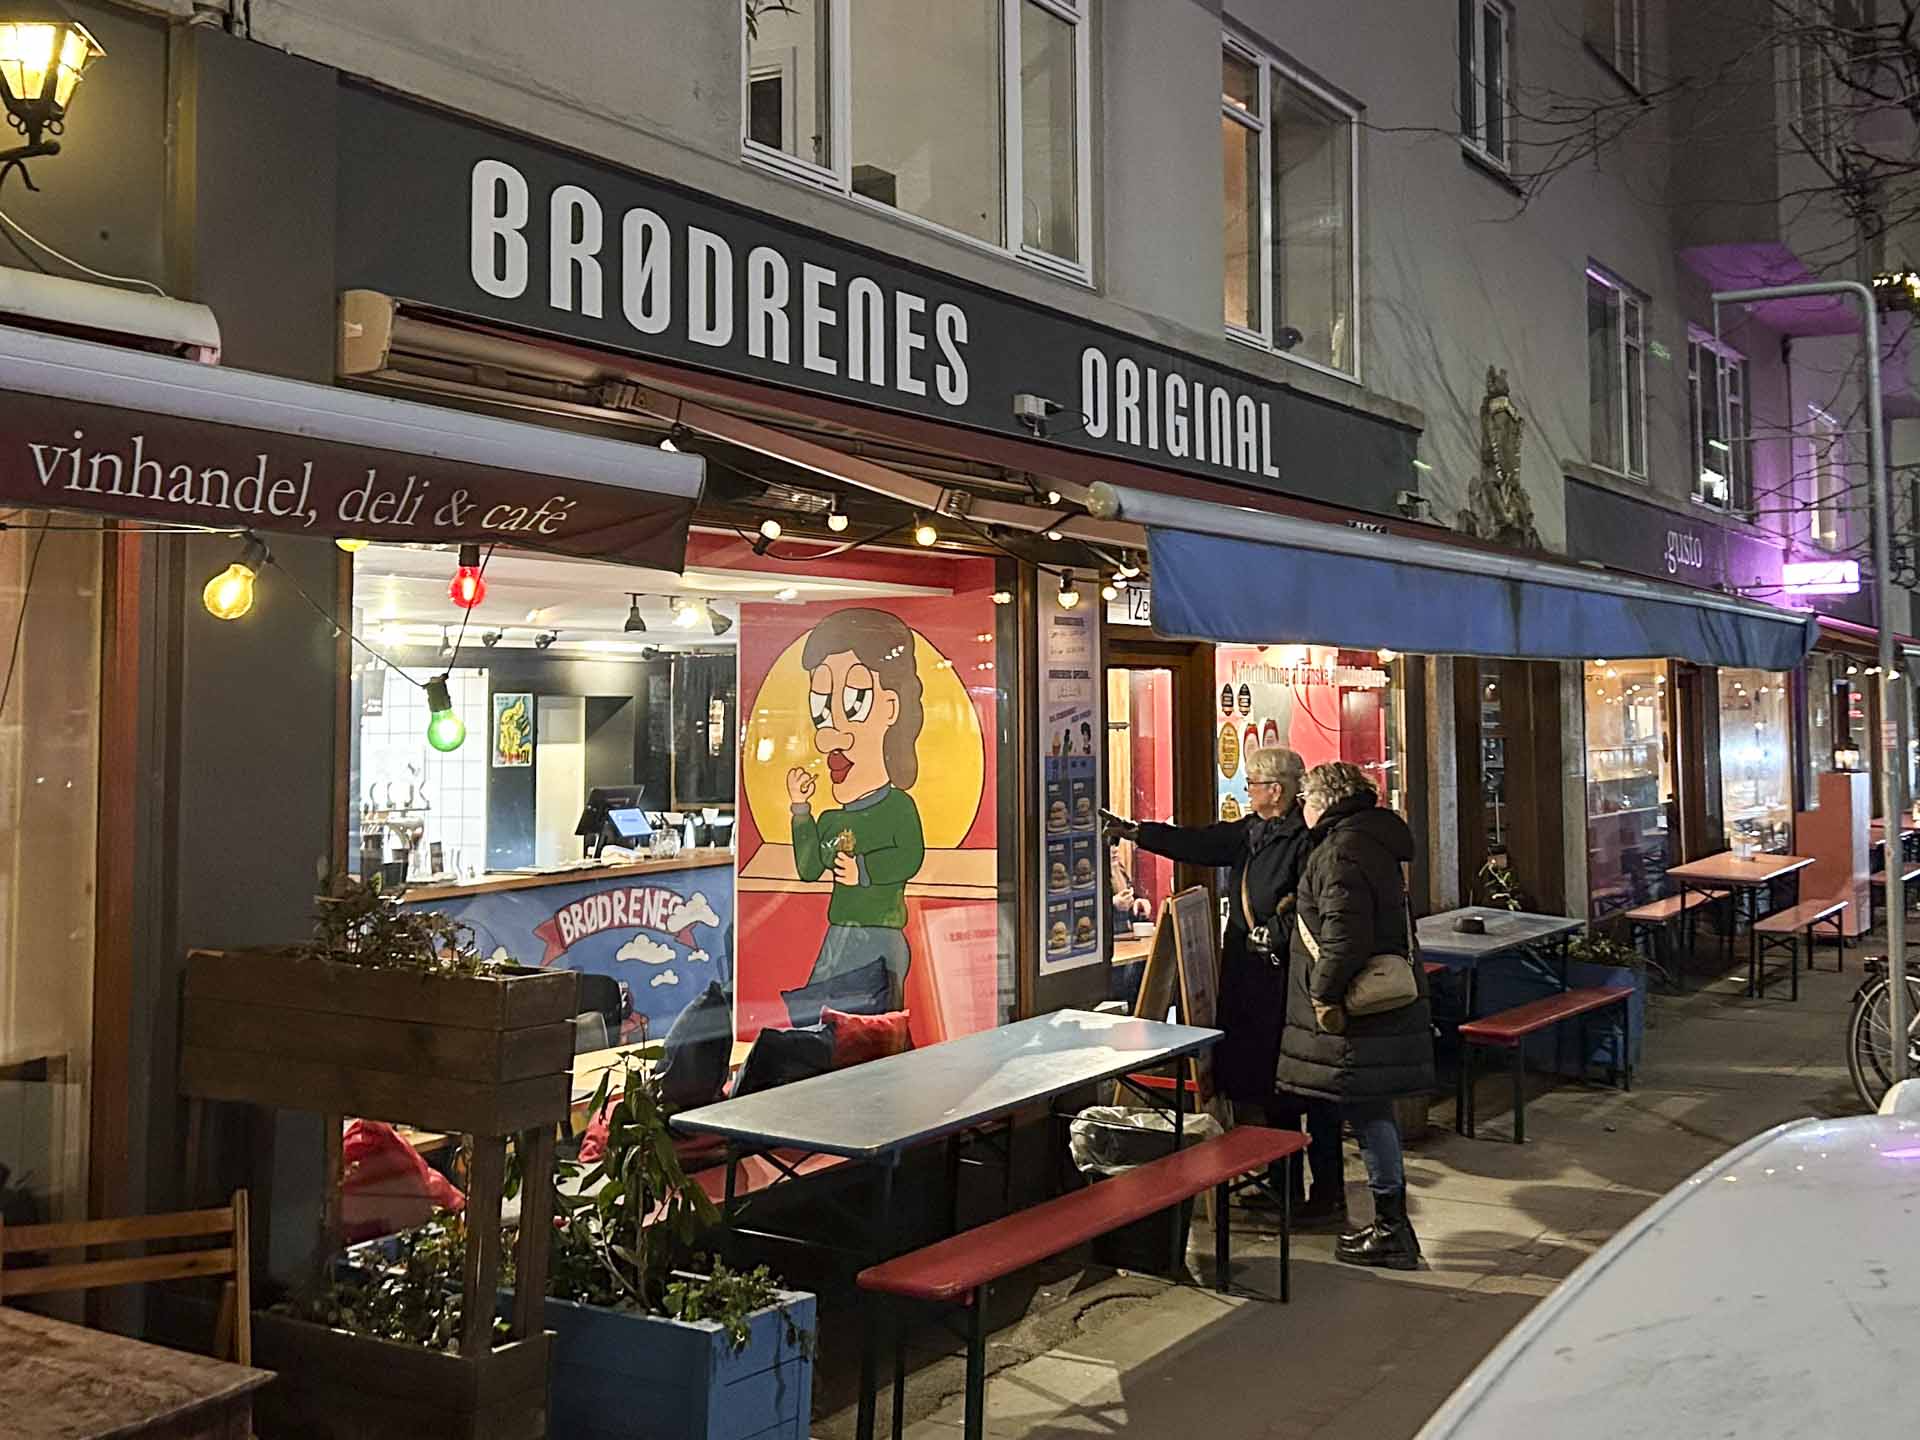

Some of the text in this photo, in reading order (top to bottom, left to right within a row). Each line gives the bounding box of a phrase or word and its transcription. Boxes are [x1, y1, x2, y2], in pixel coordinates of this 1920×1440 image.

[471, 159, 1279, 478] BRØDRENES ORIGINAL
[28, 430, 577, 534] vinhandel, deli & café
